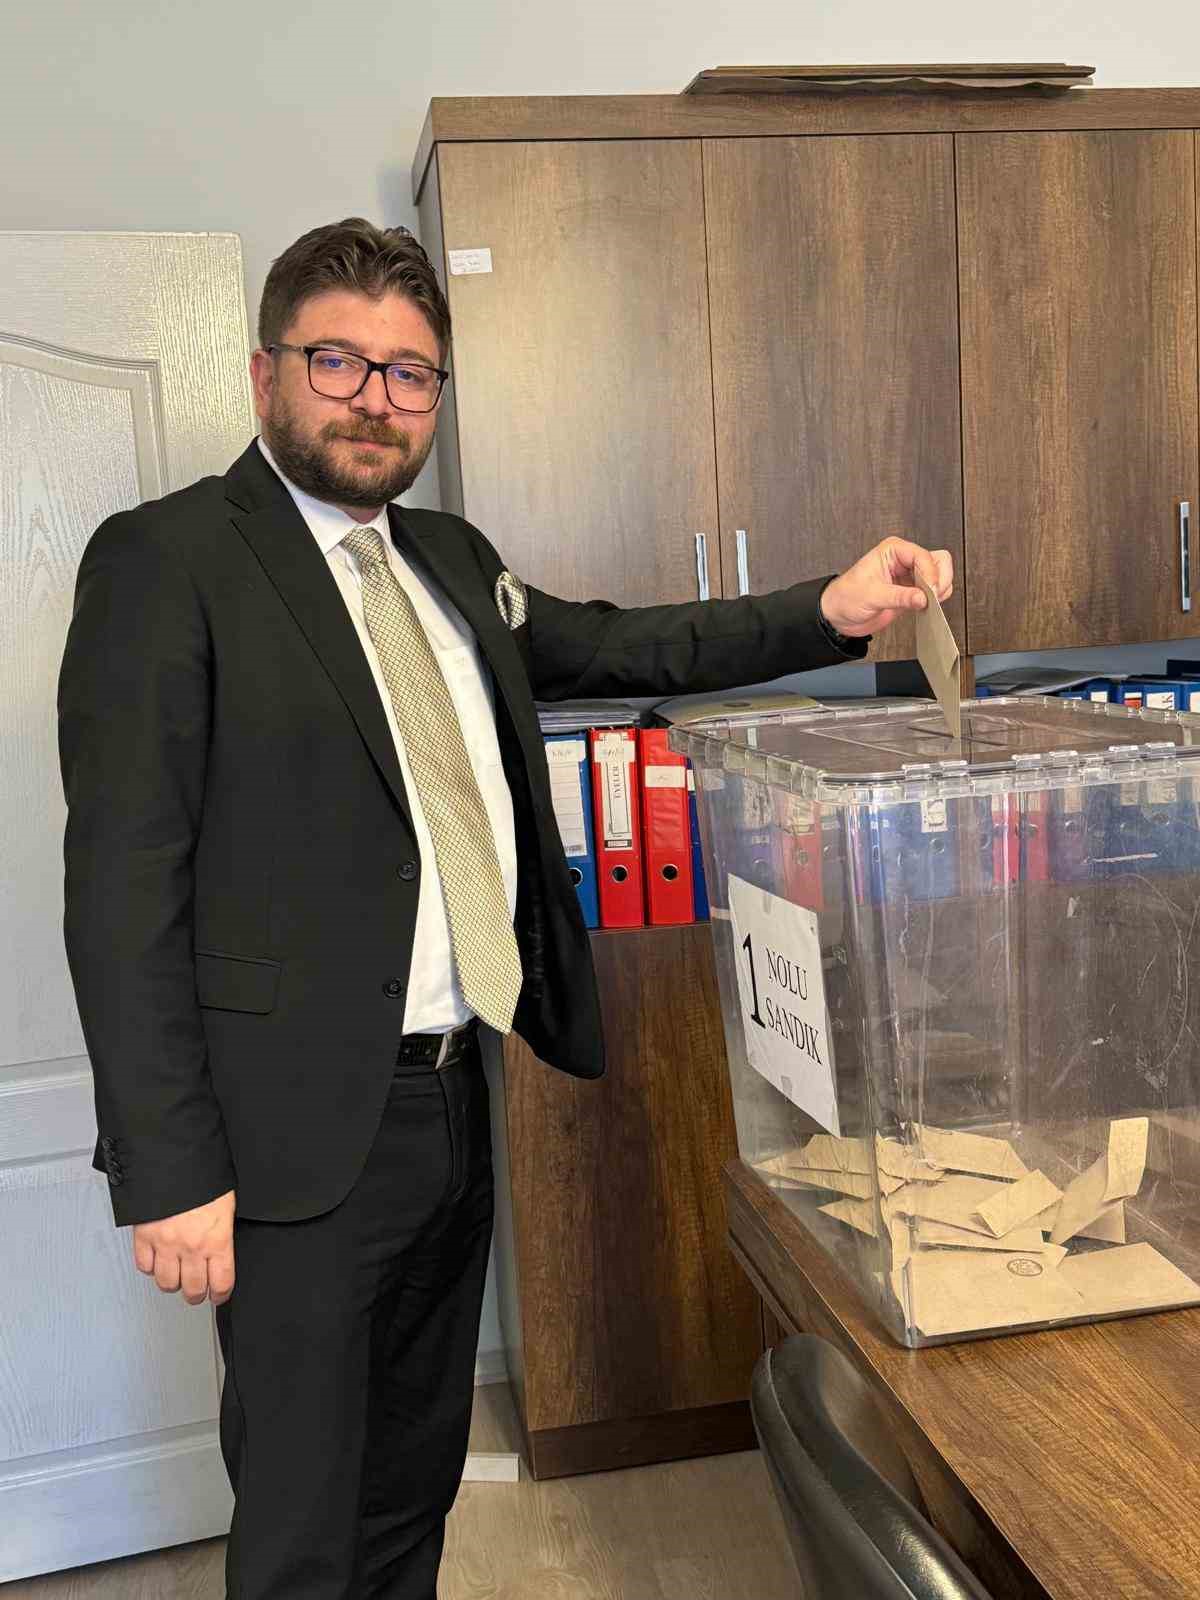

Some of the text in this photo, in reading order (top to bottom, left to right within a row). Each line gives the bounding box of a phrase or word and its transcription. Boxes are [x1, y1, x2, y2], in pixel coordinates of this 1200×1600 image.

[743, 933, 765, 1029] 1
[766, 947, 808, 1000] NOLU
[765, 997, 822, 1065] SANDIK
